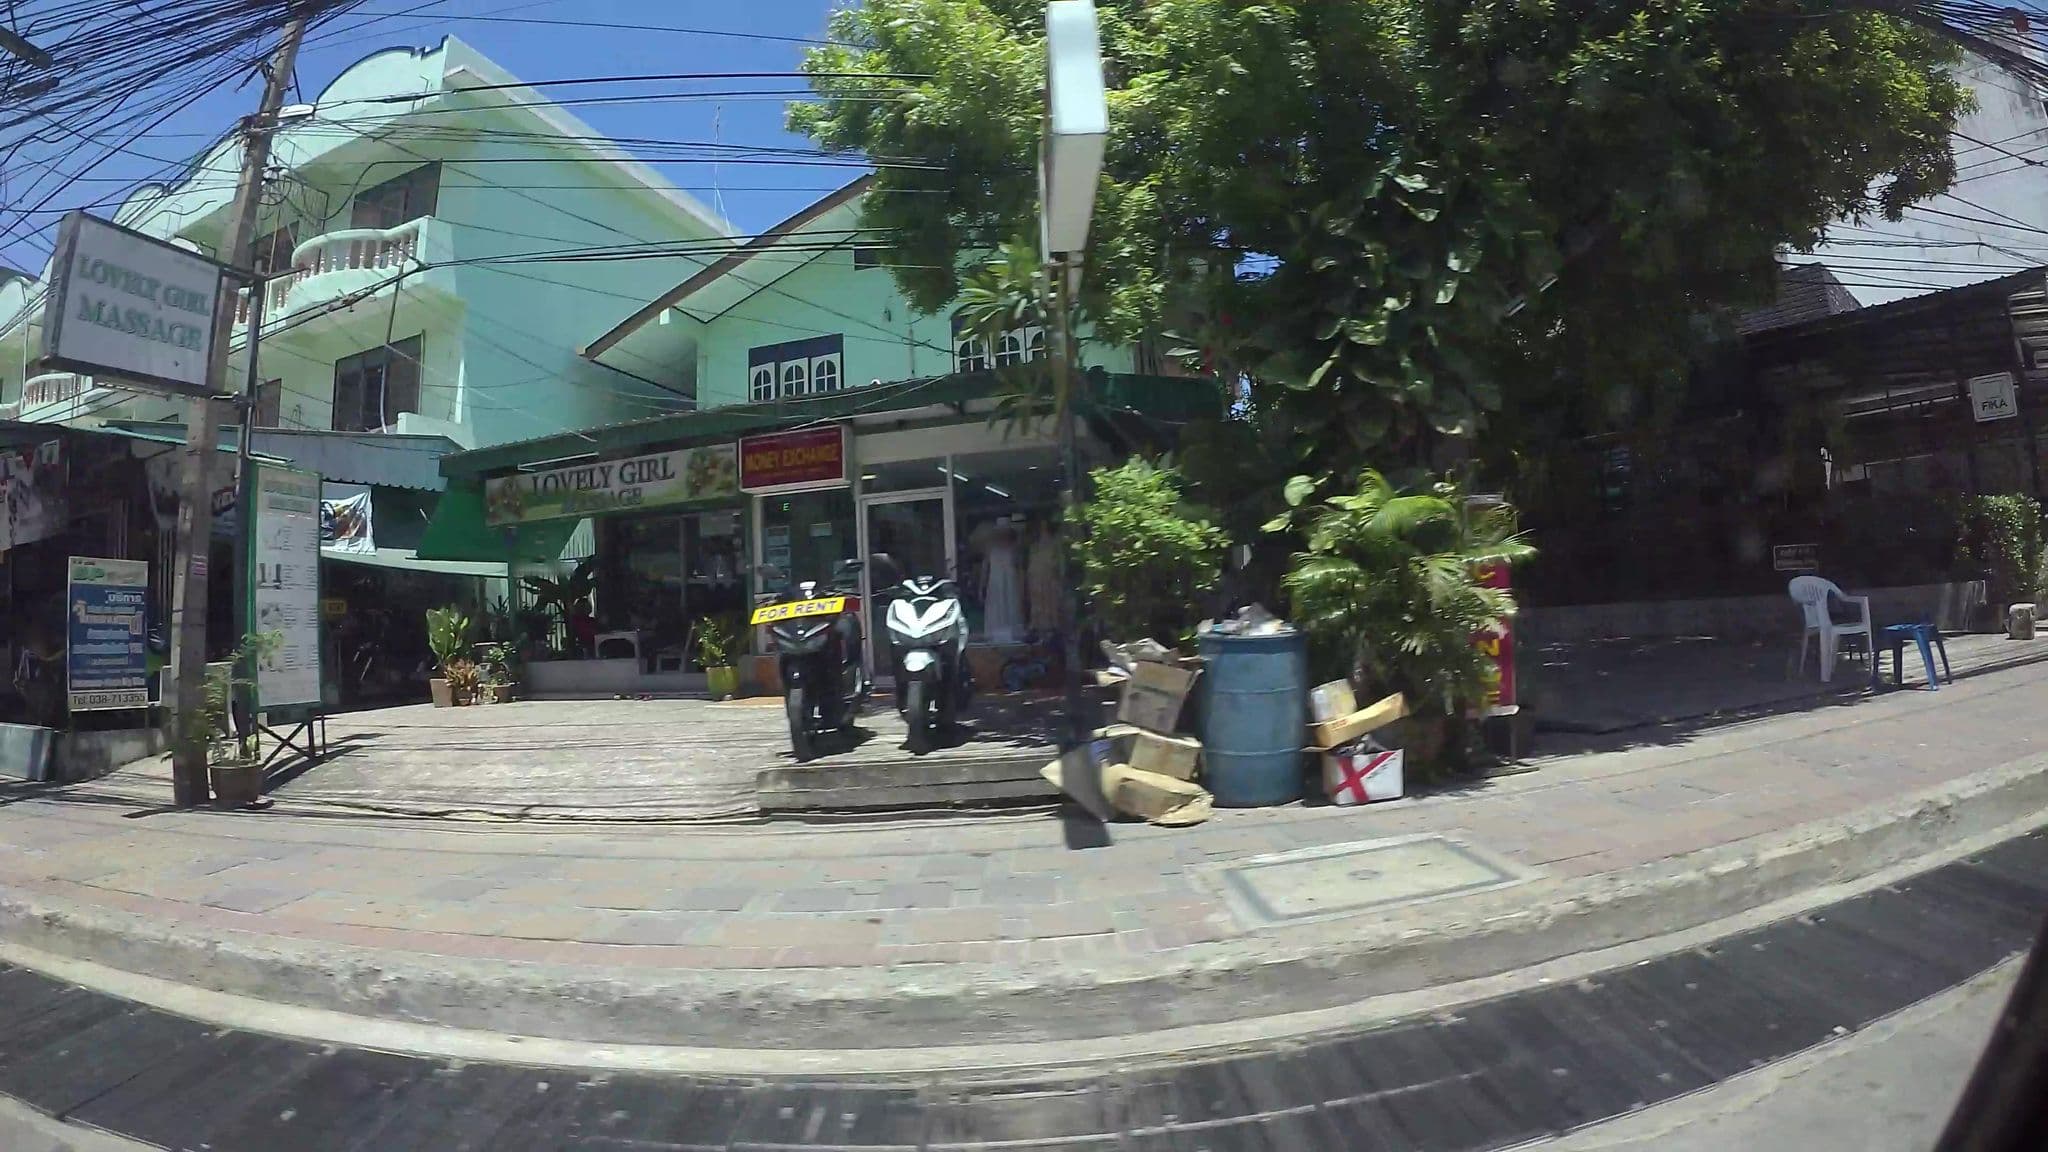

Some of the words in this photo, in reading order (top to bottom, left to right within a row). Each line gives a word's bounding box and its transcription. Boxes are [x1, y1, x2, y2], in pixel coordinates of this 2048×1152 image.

[79, 254, 161, 301] LOVELY
[163, 284, 211, 317] GIRL
[78, 293, 202, 352] MASSAGE
[782, 442, 839, 467] EXCHANGE
[532, 465, 613, 495] LOVELY
[619, 456, 676, 485] GIRL
[758, 606, 788, 620] FOR
[794, 600, 838, 615] RENT
